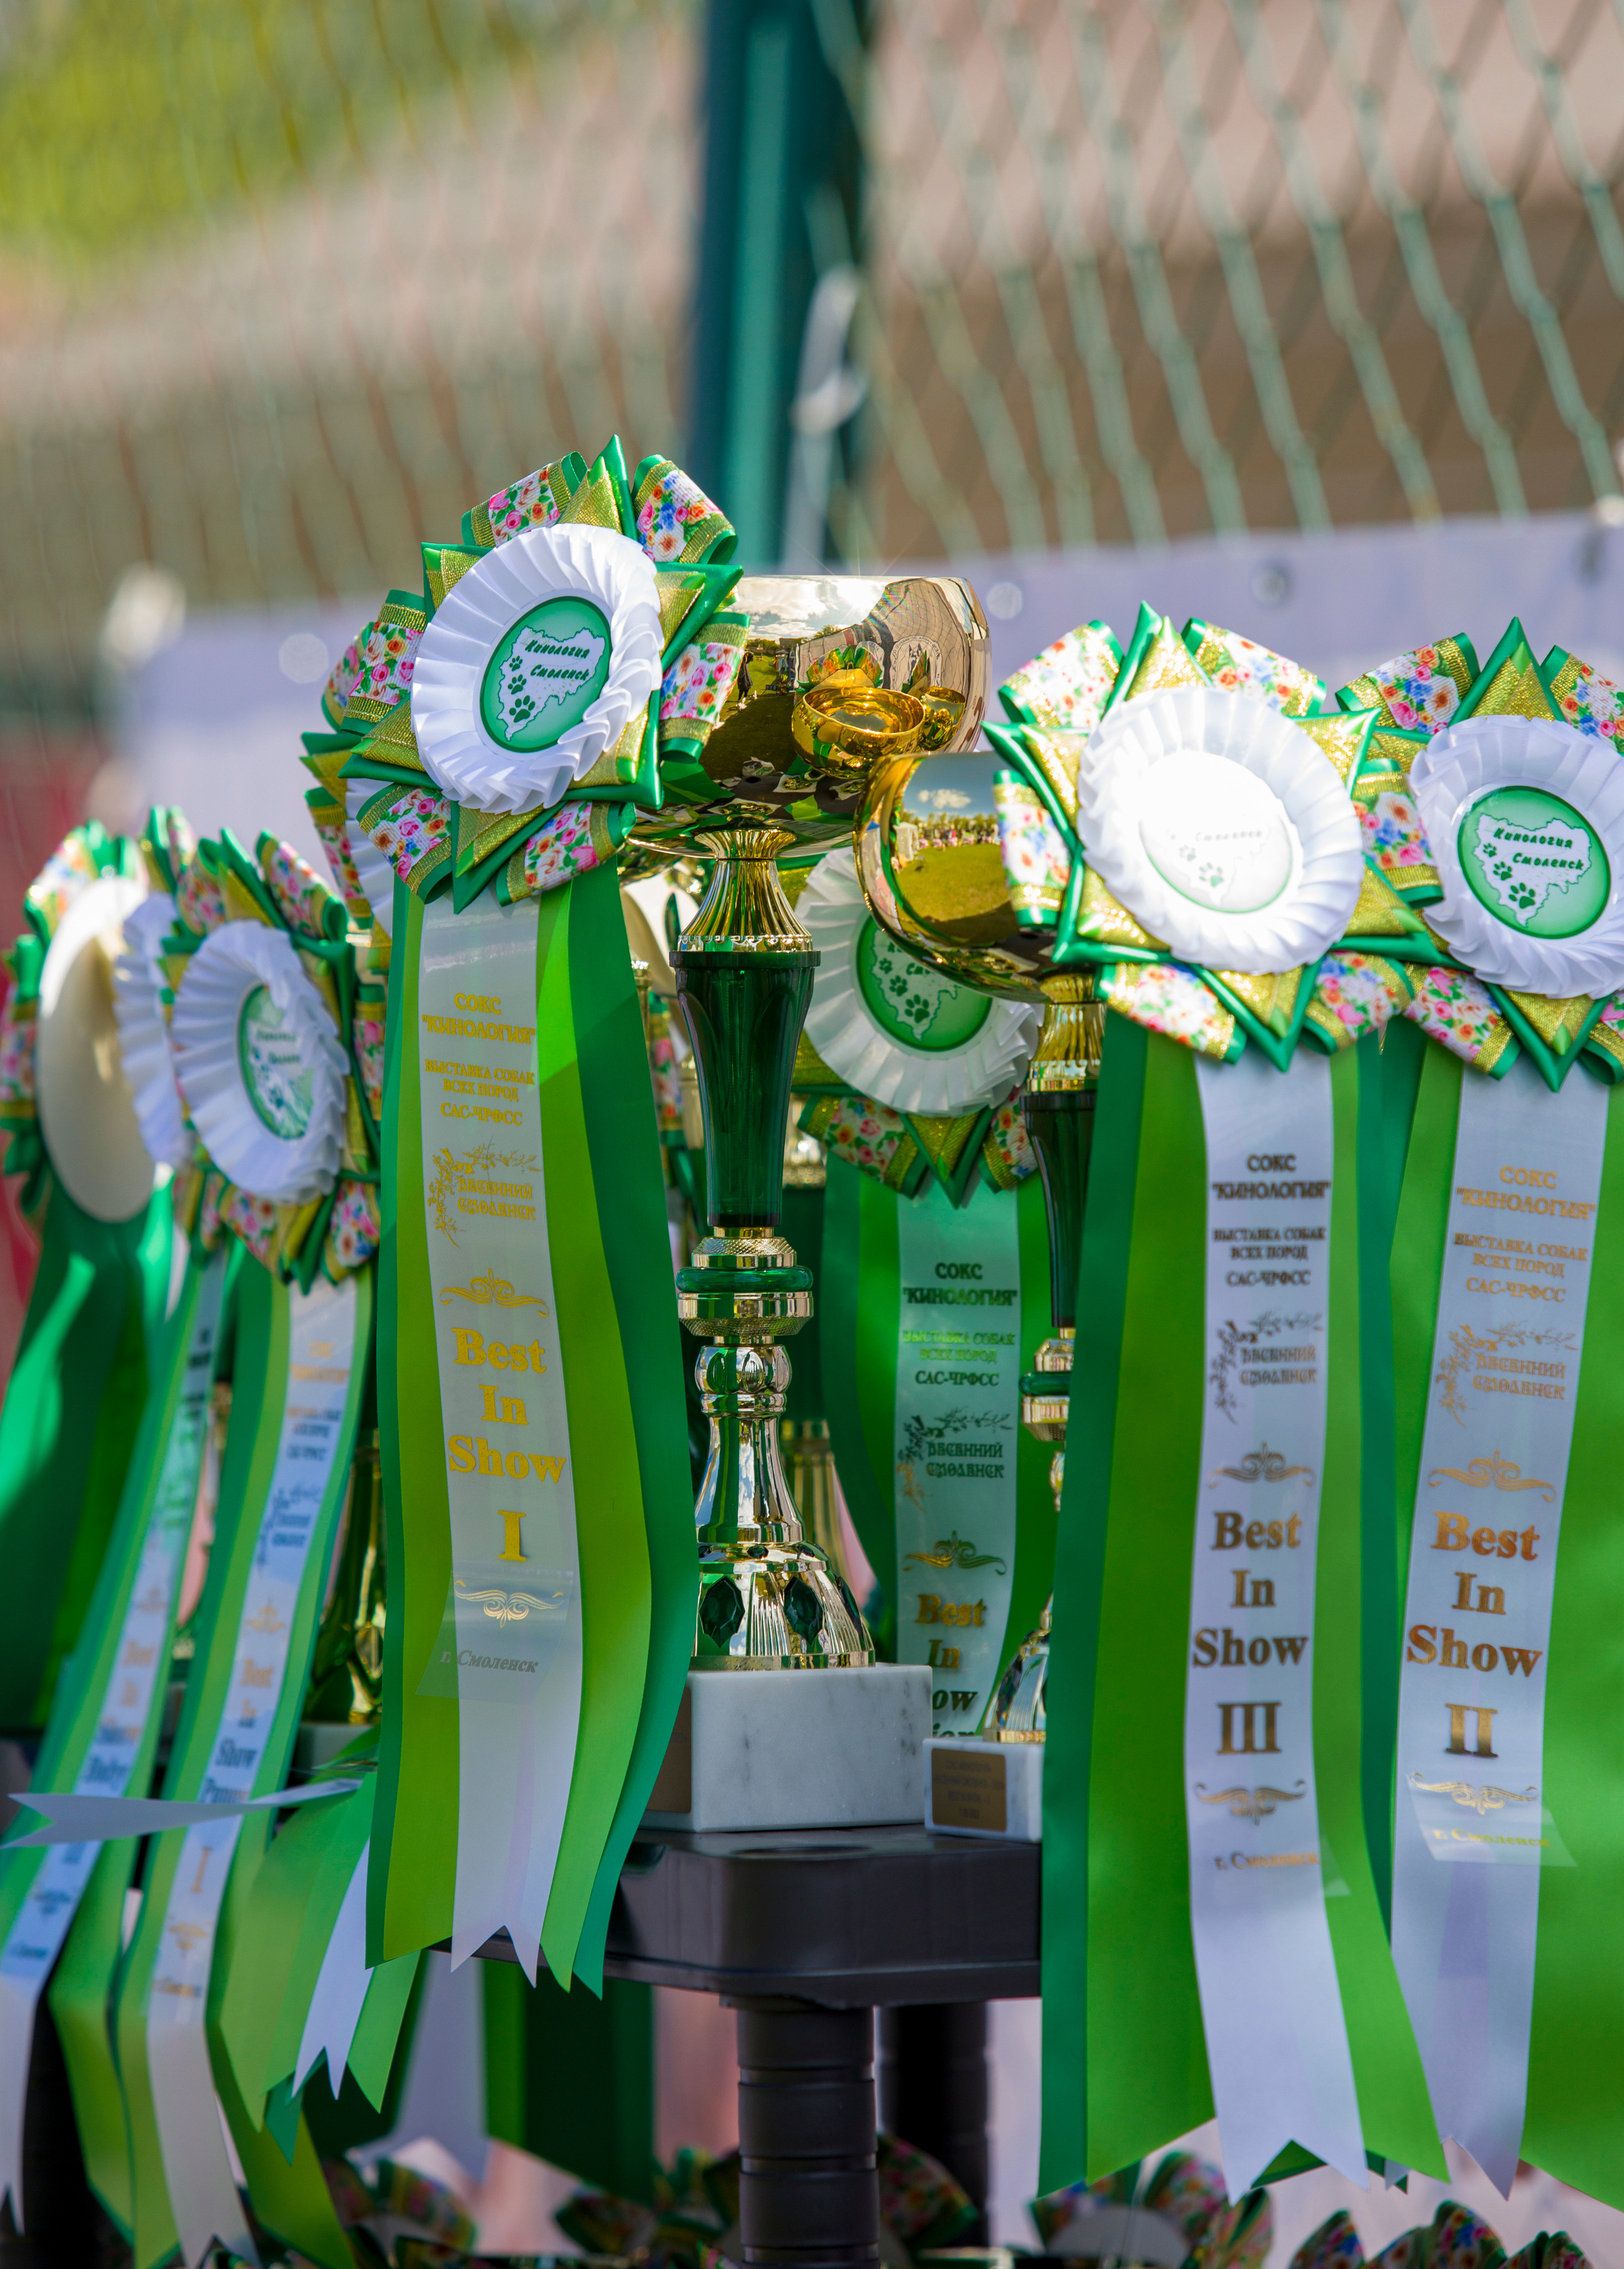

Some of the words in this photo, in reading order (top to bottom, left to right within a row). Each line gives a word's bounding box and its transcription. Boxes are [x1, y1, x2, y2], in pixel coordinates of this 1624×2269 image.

[525, 640, 590, 659] Кинология
[530, 664, 589, 681] Смоленск
[1494, 827, 1573, 849] Кинология
[1513, 852, 1585, 871] Смоленск
[454, 992, 501, 1015] СОКС
[421, 1015, 536, 1044] "КИНОЛОГИЯ"
[424, 1059, 492, 1079] ВЫСТАВКА
[494, 1068, 535, 1085] СОБАК
[443, 1078, 476, 1095] ВСЕХ
[477, 1082, 519, 1103] ПОРОД
[1247, 1154, 1296, 1173] СОКС
[457, 1176, 533, 1200] ВЕСЕННИЙ
[1212, 1181, 1332, 1200] "КИНОЛОГИЯ"
[1500, 1166, 1557, 1189] СОКС
[457, 1197, 536, 1221] СМОЛЕНСК
[1457, 1187, 1596, 1220] "КИНОЛОГИЯ"
[1453, 1232, 1534, 1254] ВЫСТАВКА
[1537, 1243, 1588, 1261] СОБАК
[934, 1262, 983, 1280] СОКС
[1472, 1253, 1511, 1270] ВСЕХ
[1515, 1258, 1565, 1278] ПОРОД
[902, 1287, 1018, 1306] "КИНОЛОГИЯ"
[451, 1327, 547, 1374] Best
[1476, 1354, 1566, 1379] ВЕСЕННИЙ
[1472, 1374, 1566, 1400] СМОЛЕНСК
[479, 1383, 529, 1426] In
[448, 1434, 566, 1484] Show
[497, 1509, 527, 1562] I
[1211, 1511, 1303, 1551] Best
[1431, 1510, 1541, 1562] Best
[1229, 1569, 1277, 1609] In
[1452, 1571, 1507, 1616] In
[914, 1594, 986, 1627] Best
[927, 1639, 960, 1669] In
[1193, 1627, 1309, 1668] Show
[1406, 1624, 1543, 1678] Show
[457, 1650, 539, 1673] Смоленск
[1216, 1701, 1283, 1756] III
[1444, 1702, 1500, 1758] II
[1451, 1829, 1552, 1848] Смоленск
[1231, 1851, 1321, 1870] Смоленск
